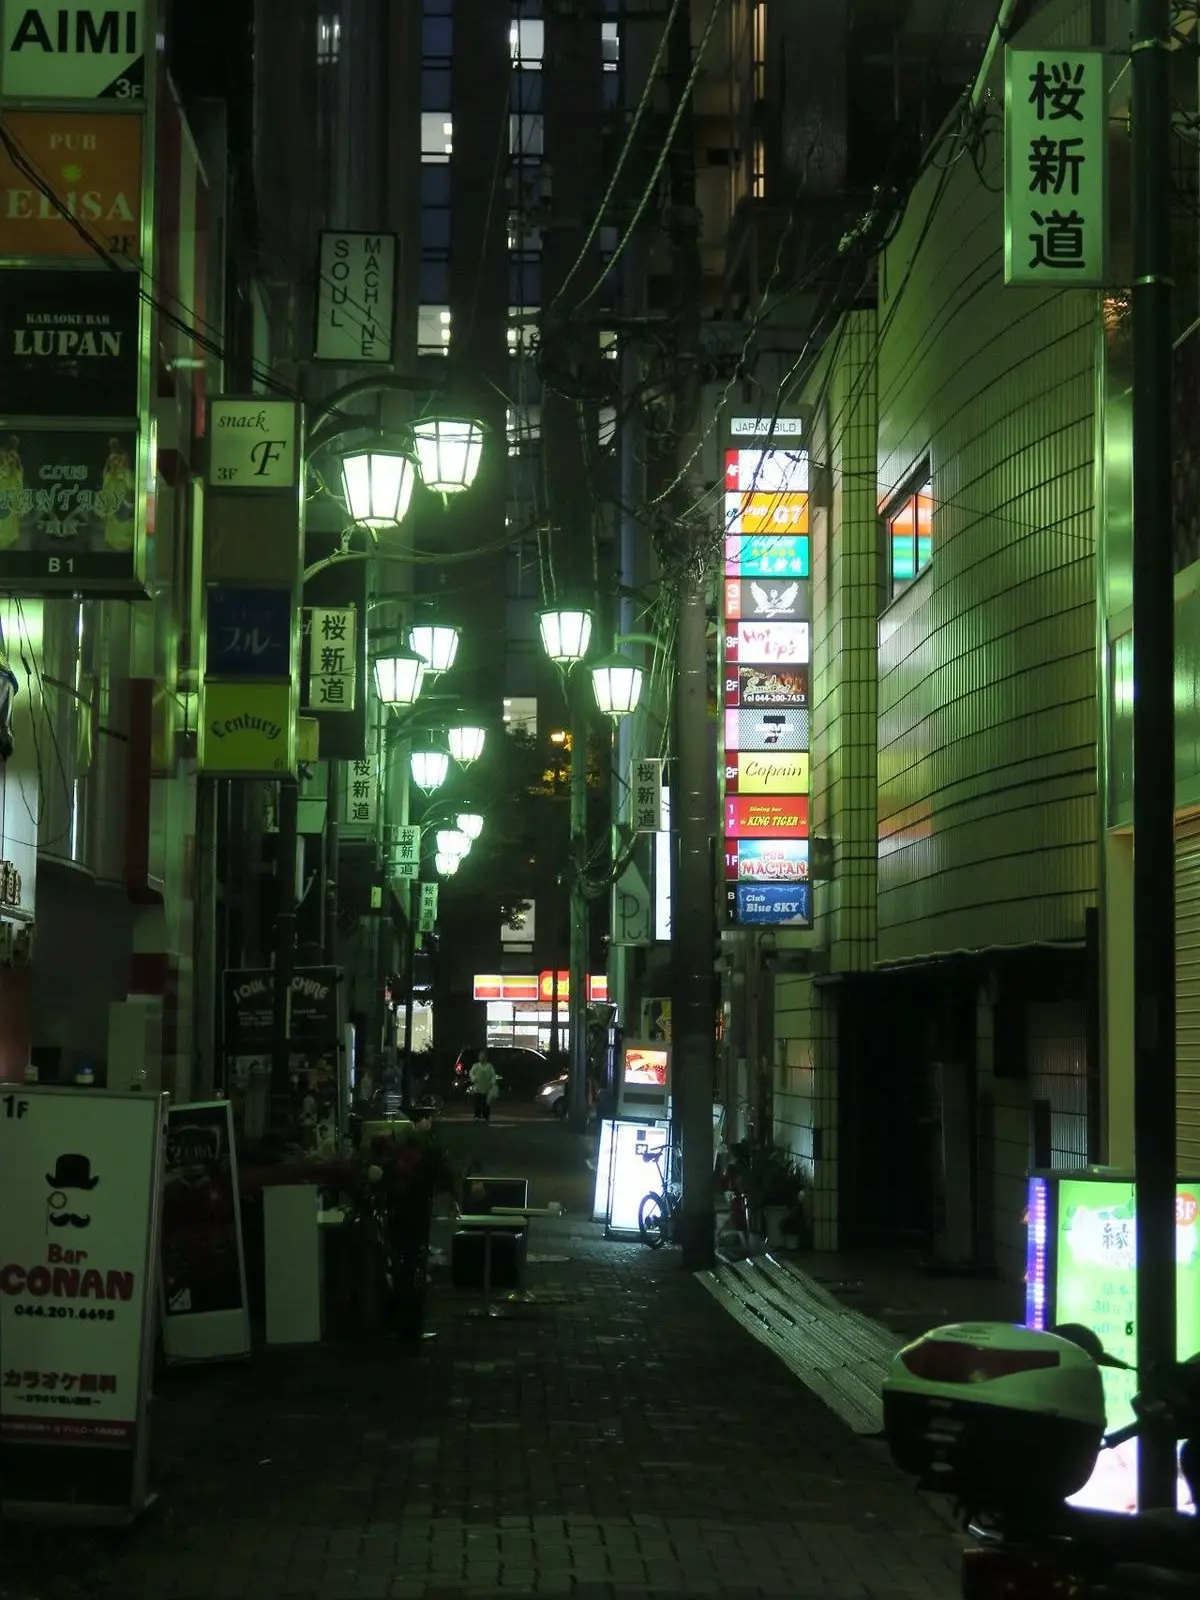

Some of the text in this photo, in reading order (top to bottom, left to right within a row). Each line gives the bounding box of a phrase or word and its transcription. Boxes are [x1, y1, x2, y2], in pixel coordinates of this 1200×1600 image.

[10, 9, 138, 54] AIMI
[115, 78, 142, 99] 3F
[49, 132, 97, 152] PUB
[1028, 60, 1086, 269] 桜新道
[108, 234, 136, 254] 2F
[330, 239, 350, 328] SOUL
[361, 237, 382, 358] MACHINE
[13, 329, 123, 357] LUPAN
[217, 410, 269, 432] snack
[735, 422, 769, 433] JAPAN
[251, 440, 287, 476] F
[217, 466, 238, 481] 3F
[321, 614, 346, 705] 桜新道
[726, 680, 738, 692] 2F
[211, 712, 282, 740] Century
[725, 767, 738, 778] 2F
[745, 760, 802, 786] Copain
[352, 759, 371, 821] 桜新道
[636, 763, 655, 829] 桜新道
[747, 815, 799, 827] KING TIGER
[401, 828, 415, 876] 桜新道
[725, 854, 738, 866] 1F
[743, 861, 806, 875] MACTAN
[746, 894, 766, 902] Club
[746, 902, 800, 913] Blue SKY
[4, 1094, 29, 1119] 1F
[47, 1243, 88, 1266] Bar
[0, 1263, 134, 1301] CONAN
